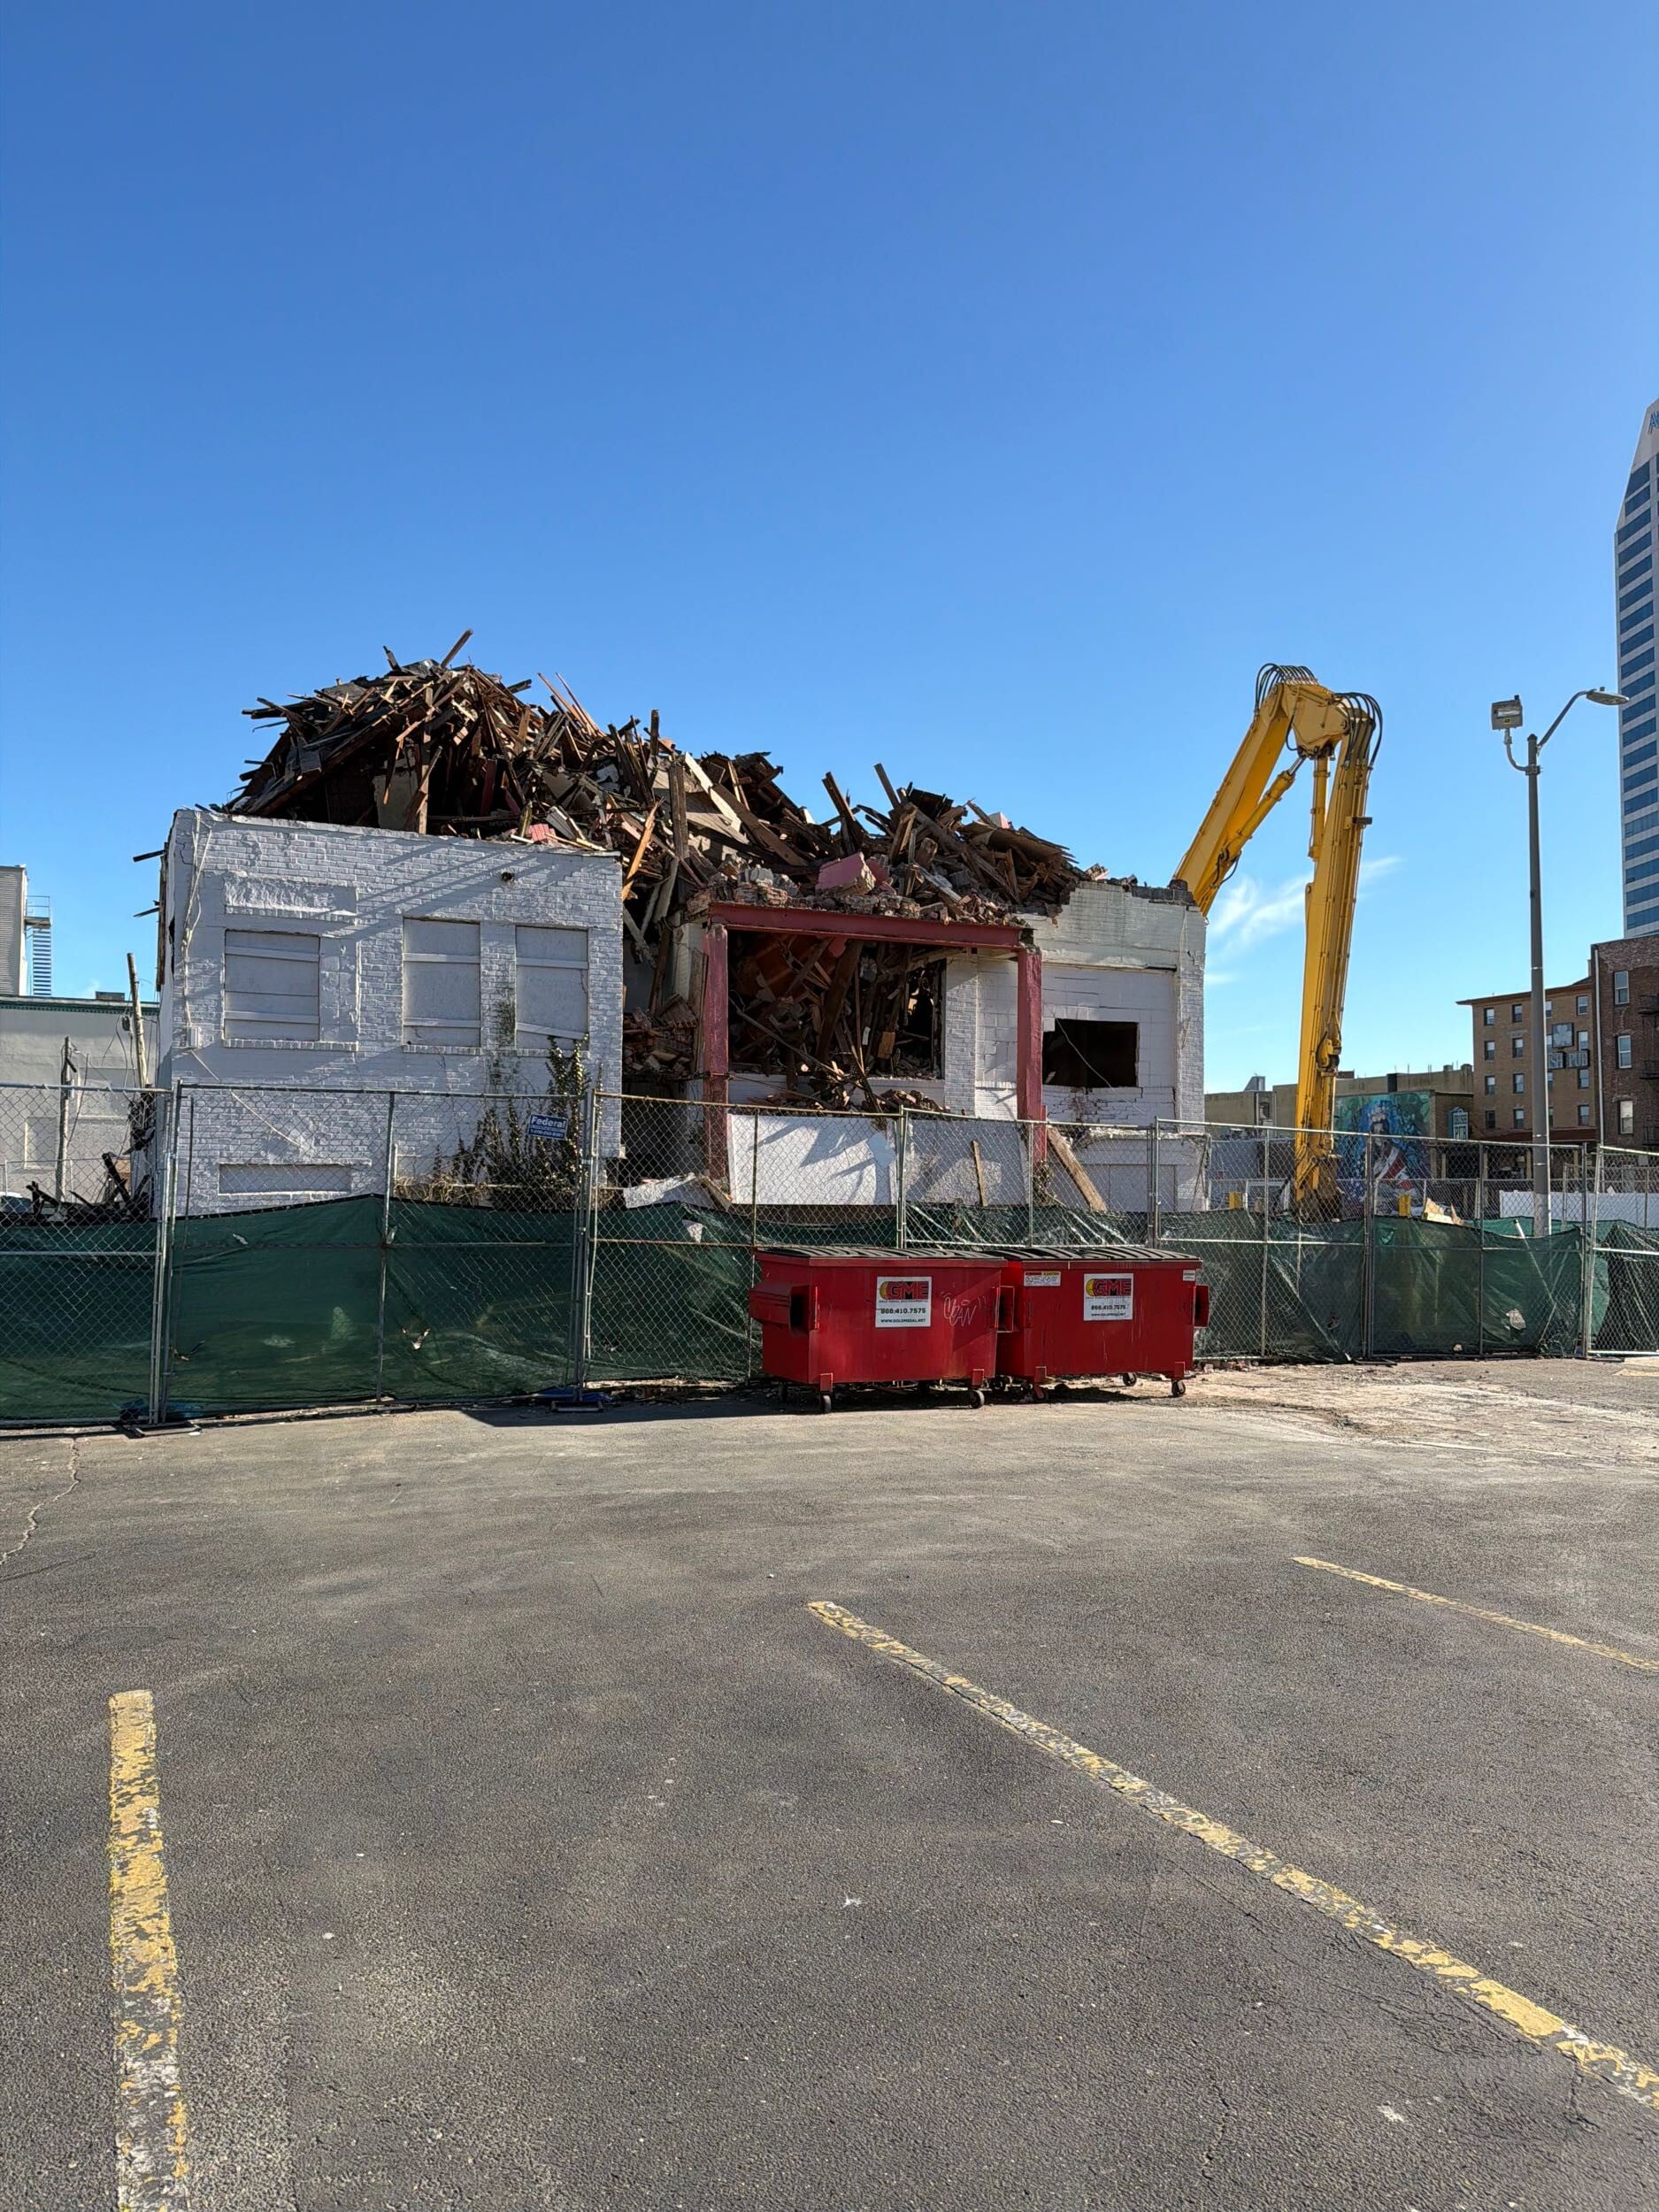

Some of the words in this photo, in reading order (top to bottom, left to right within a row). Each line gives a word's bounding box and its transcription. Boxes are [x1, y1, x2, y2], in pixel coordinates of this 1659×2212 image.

[1568, 1052, 1588, 1067] PUB
[531, 1116, 566, 1128] Federal
[887, 1281, 928, 1300] GME
[1094, 1279, 1131, 1296] GME
